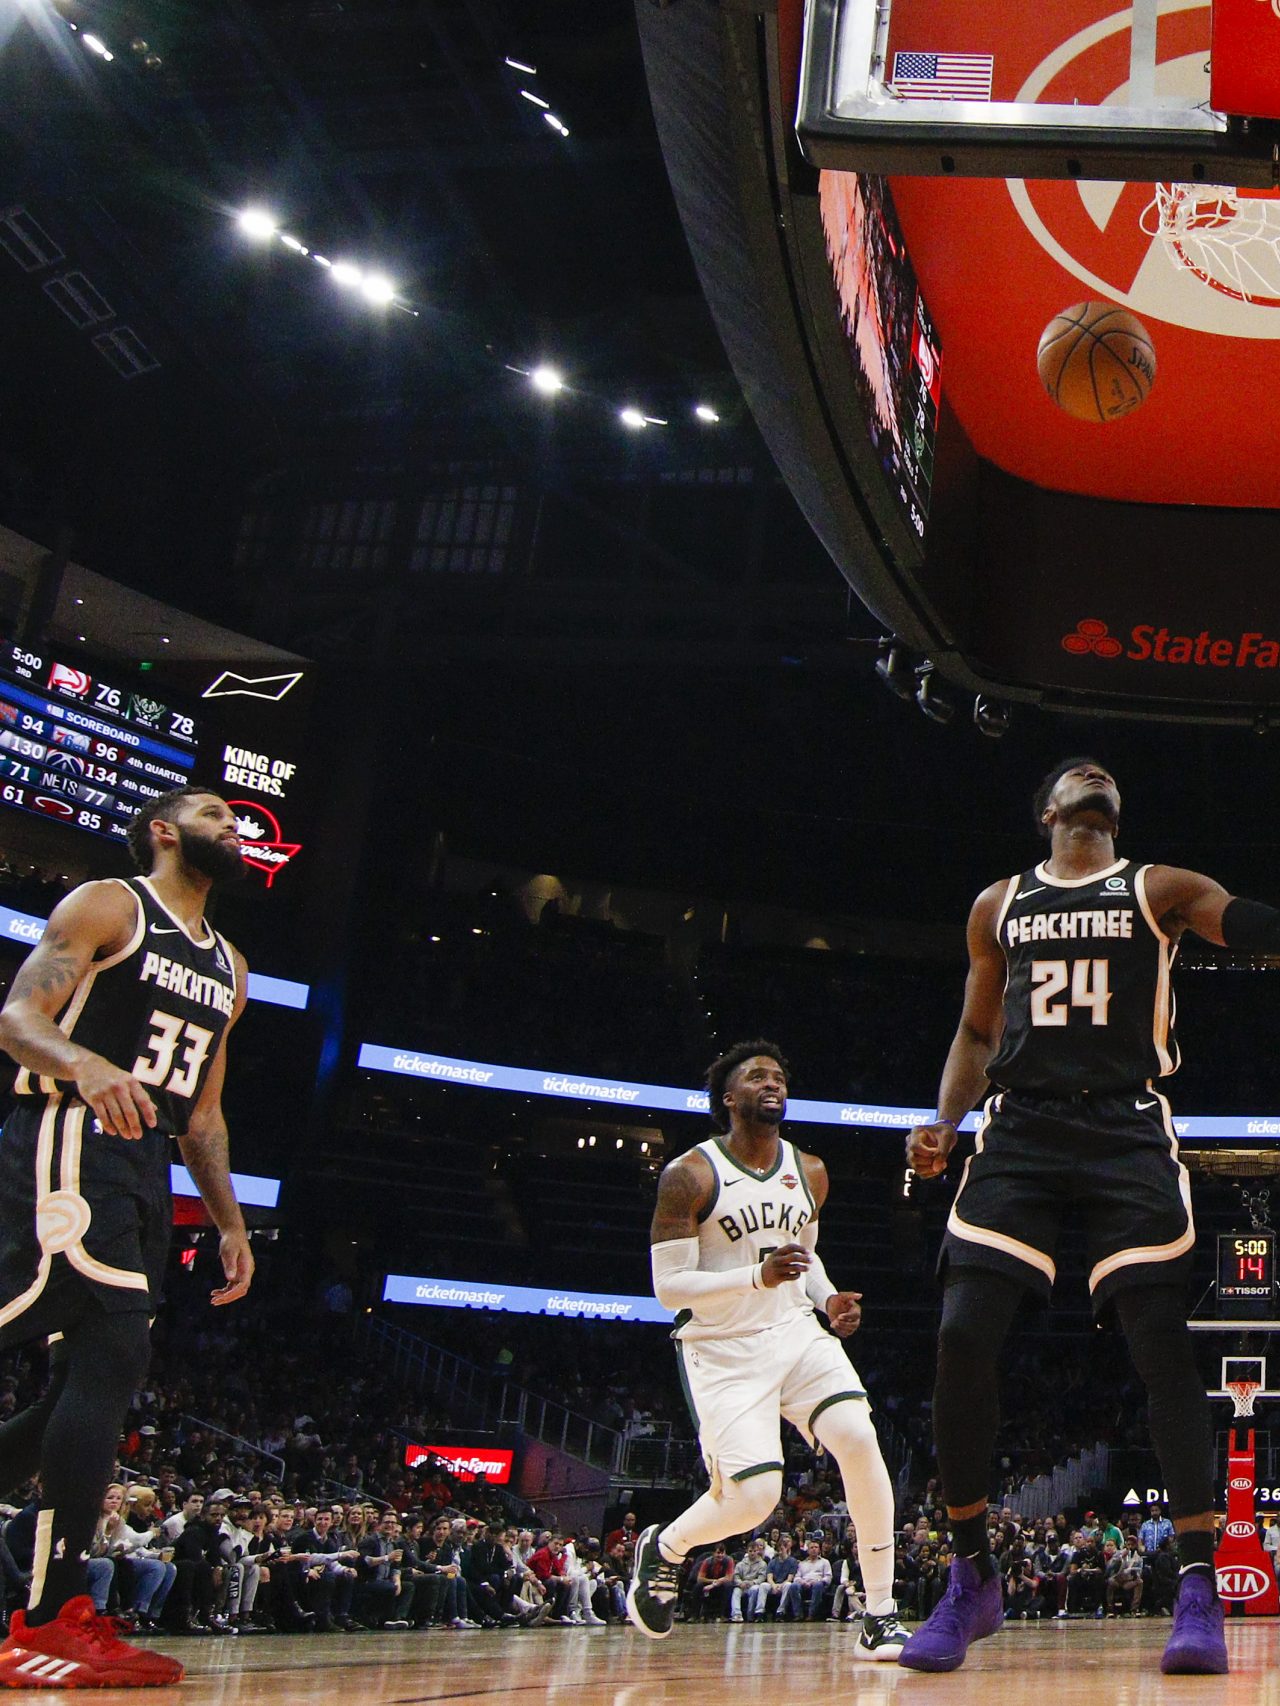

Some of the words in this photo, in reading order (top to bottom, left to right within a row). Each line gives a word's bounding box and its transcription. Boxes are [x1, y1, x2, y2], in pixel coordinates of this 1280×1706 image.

[12, 647, 42, 670] 5:00
[15, 666, 32, 678] 3RD
[96, 683, 121, 706] 76
[22, 715, 44, 734] 94
[66, 712, 140, 746] SCOREBOARD
[170, 712, 194, 734] 78
[11, 736, 44, 759] 130
[9, 761, 31, 782] 71
[95, 743, 119, 762] 96
[127, 757, 143, 769] 4th
[144, 760, 188, 785] QUARTER
[224, 745, 269, 773] KING
[271, 760, 296, 780] OF
[41, 773, 78, 796] NETS
[85, 763, 118, 786] 134
[121, 779, 138, 792] 4th
[224, 764, 285, 798] BEERS.
[3, 785, 24, 805] 61
[84, 788, 107, 806] 77
[116, 801, 133, 814] 3rd
[78, 810, 102, 829] 85
[1006, 909, 1133, 948] PEACHTREE
[139, 951, 234, 1019] PEACHTREE
[1031, 959, 1113, 1026] 24
[132, 1009, 215, 1098] 33
[392, 1054, 494, 1084] ticketmaster
[542, 1076, 640, 1102] ticketmaster
[841, 1107, 930, 1126] ticketmaster
[718, 1202, 808, 1242] BUCKS
[1234, 1240, 1267, 1256] 5:00
[1238, 1258, 1264, 1280] 14
[416, 1284, 505, 1305] ticketmaster
[547, 1296, 632, 1315] ticketmaster
[1230, 1524, 1252, 1534] KIA
[1217, 1573, 1259, 1592] KIA
